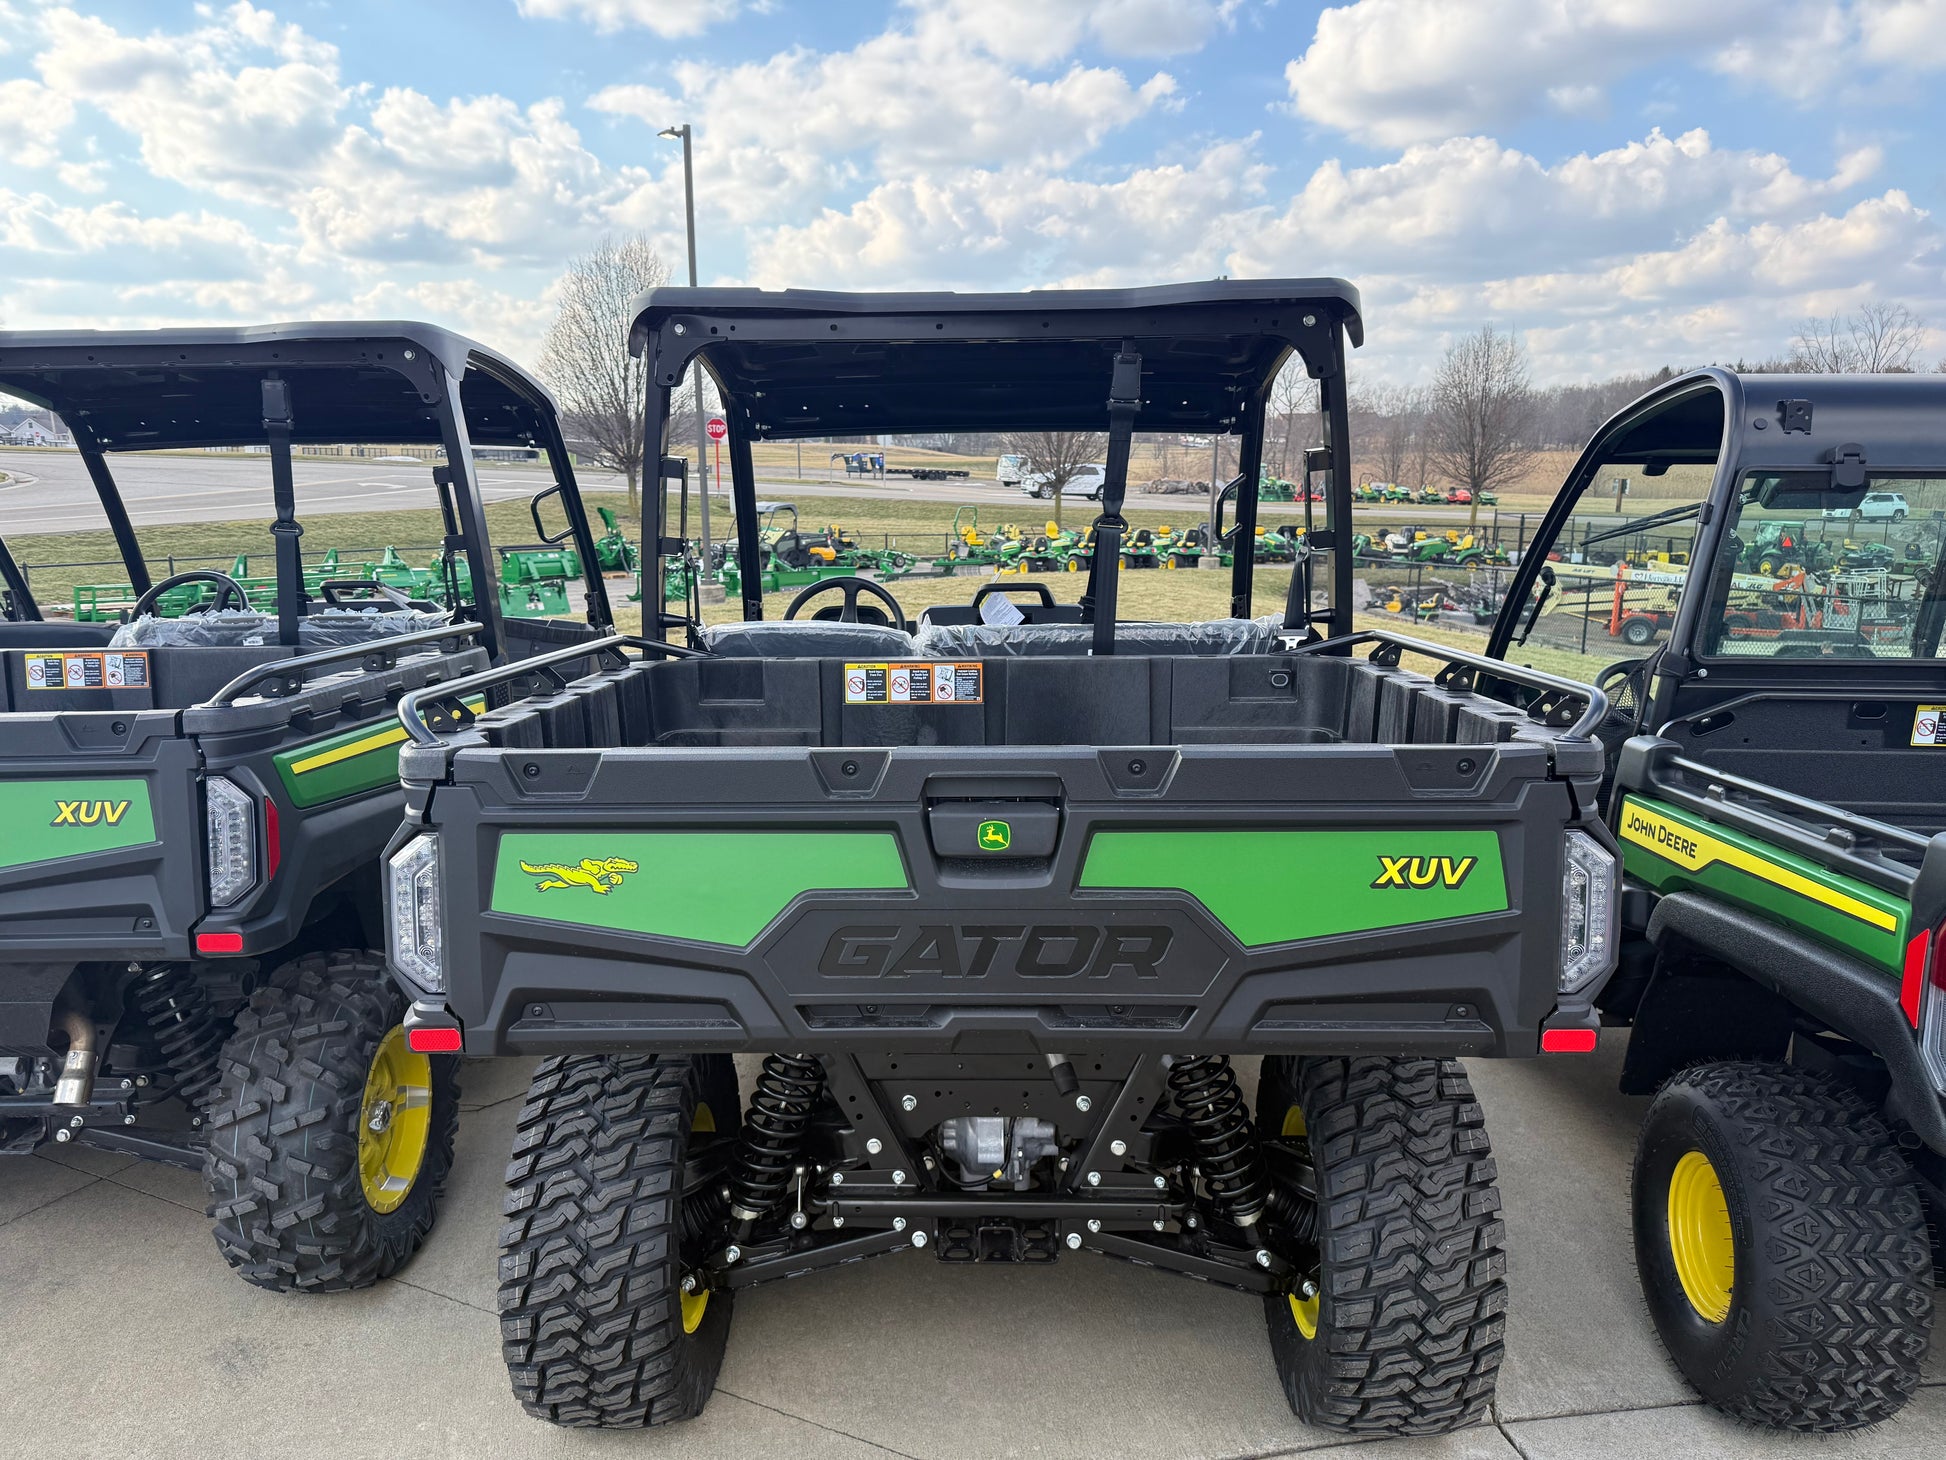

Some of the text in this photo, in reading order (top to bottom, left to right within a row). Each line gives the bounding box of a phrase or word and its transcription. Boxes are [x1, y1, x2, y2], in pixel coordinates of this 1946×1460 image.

[707, 424, 726, 433] STOP
[49, 800, 132, 827] XUV
[1627, 812, 1698, 859] JOHN DEERE
[1369, 856, 1478, 889] XUV
[817, 925, 1174, 978] GATOR
